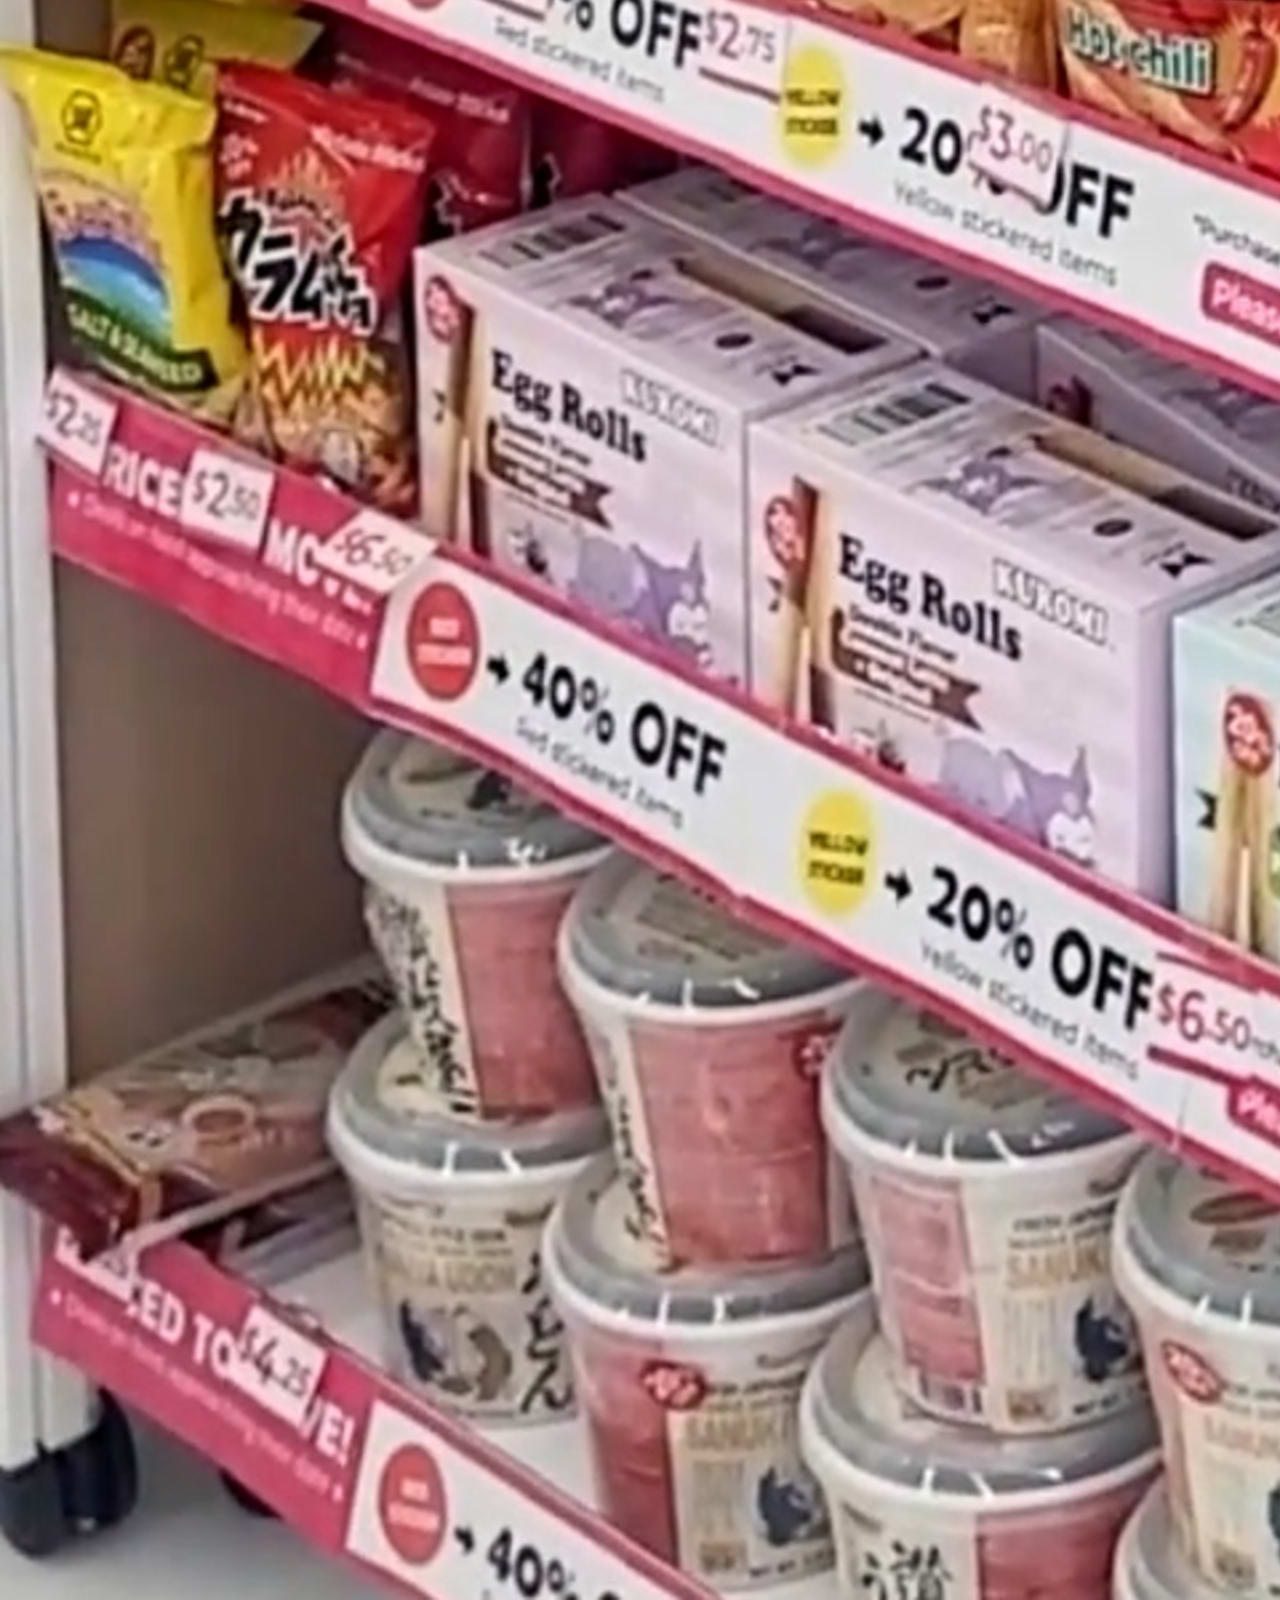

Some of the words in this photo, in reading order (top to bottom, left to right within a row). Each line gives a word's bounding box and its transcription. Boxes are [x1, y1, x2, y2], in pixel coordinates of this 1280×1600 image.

[705, 13, 776, 63] $2.75
[1066, 10, 1122, 60] Hot
[1130, 32, 1214, 89] chili
[977, 106, 1055, 176] $3.00
[959, 208, 1053, 266] stickered
[1059, 244, 1119, 289] items
[492, 349, 553, 426] Egg
[560, 393, 648, 465] Rolls
[192, 471, 261, 521] $2.50
[839, 532, 914, 617] Egg
[922, 584, 1024, 662] Rolls
[992, 556, 1111, 648] KUROMI
[521, 653, 614, 742] 40%
[629, 703, 727, 796] OFF
[926, 864, 1036, 971] 20%
[1050, 926, 1153, 1032] OFF
[1157, 981, 1252, 1051] $6.50
[239, 1326, 314, 1398] $4.25
